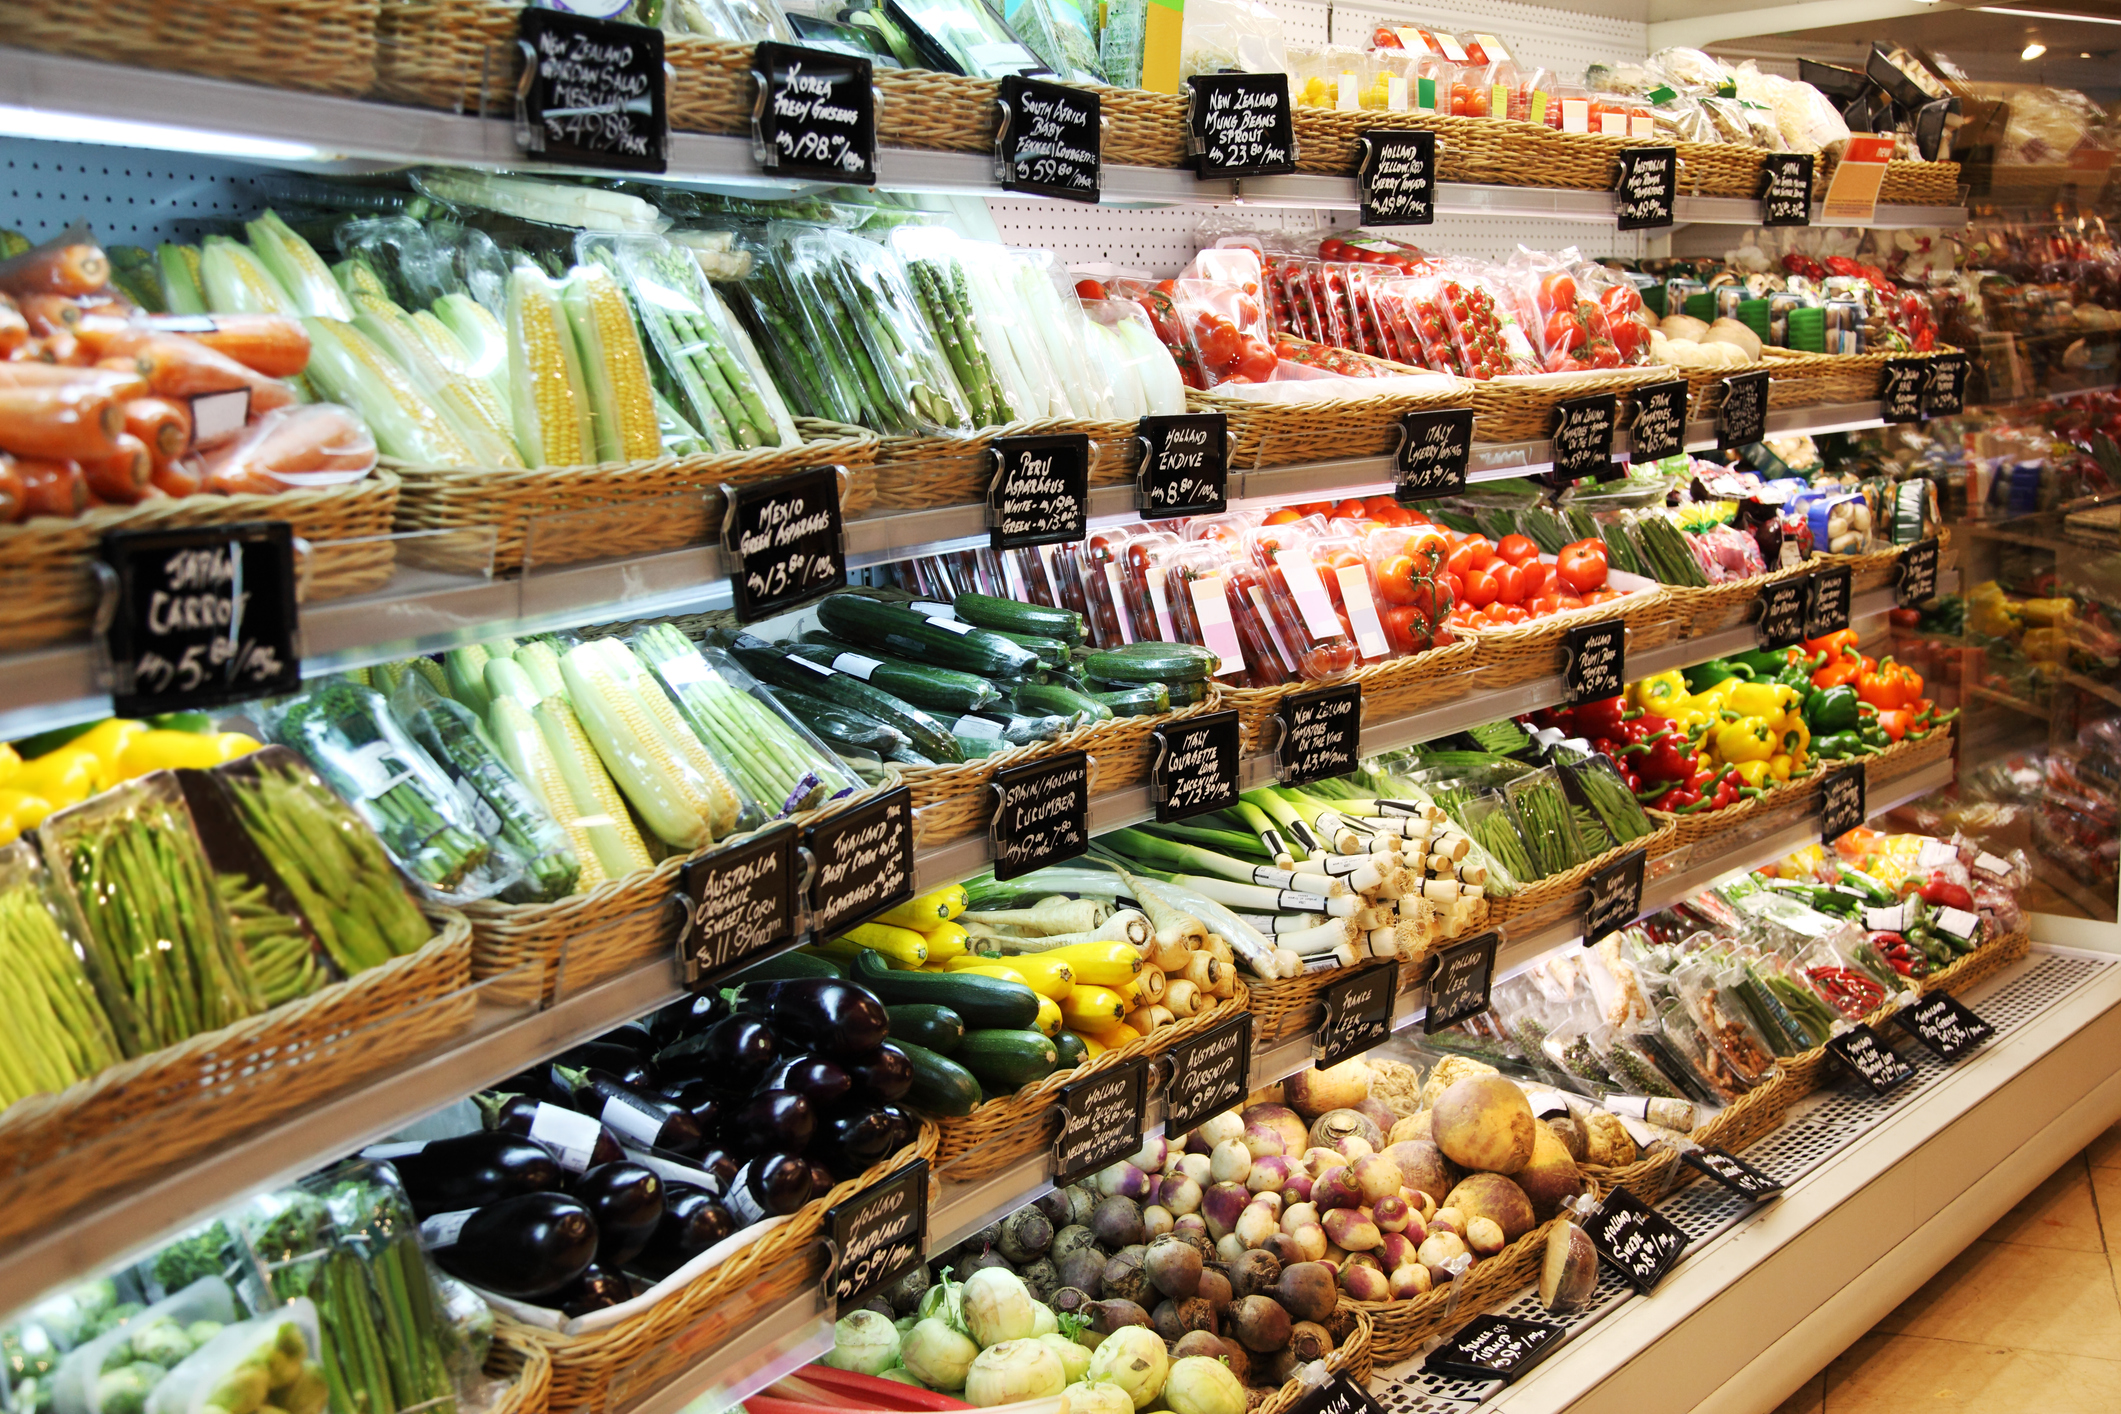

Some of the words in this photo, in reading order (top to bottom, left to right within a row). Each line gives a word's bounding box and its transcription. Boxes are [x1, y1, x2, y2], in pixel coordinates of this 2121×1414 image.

[1022, 92, 1054, 122] SOUTH
[1210, 89, 1231, 110] NEW
[1234, 89, 1277, 110] ZEALAND
[1030, 117, 1064, 141] BABY
[1205, 112, 1236, 134] MUNG
[1239, 110, 1276, 131] BEANS
[1219, 128, 1264, 144] SPROUT
[1380, 144, 1417, 161] HOLLAND
[1371, 174, 1401, 196] CHERRY
[1164, 428, 1207, 450] HOLLAND
[1425, 423, 1455, 443] ITALY
[1020, 451, 1052, 477] PERU
[1159, 451, 1204, 471] ENDIVE
[1408, 441, 1440, 467] CHERRY
[1005, 470, 1065, 497] ASPARAGUS
[1004, 498, 1033, 514] WHITE
[741, 529, 773, 558] GREEN
[774, 510, 830, 546] ASPARAGUS
[1003, 518, 1031, 534] GREEN
[1585, 634, 1612, 653] HOLLAND
[1293, 706, 1314, 725] NEW
[1182, 729, 1210, 750] ITALY
[1291, 722, 1327, 743] TOMATOES
[1168, 746, 1217, 773] COURGETTE
[1015, 791, 1075, 832] CUCUMBER
[833, 821, 887, 862] THAILAND
[704, 852, 777, 900] AUSTRALIA
[821, 858, 852, 887] BABY
[851, 847, 878, 873] CORN
[696, 886, 751, 925] ORGANIC
[823, 880, 876, 921] ASPARAGUS
[704, 906, 743, 940] SWEET
[747, 897, 776, 922] CORN
[1449, 952, 1481, 980] HOLLAND
[1445, 974, 1471, 995] LEEK
[1342, 989, 1372, 1011] FRANCE
[1333, 1012, 1362, 1034] LEEK
[1186, 1031, 1239, 1071] AUSTRALIA
[1181, 1056, 1234, 1095] PARSNIP
[1084, 1080, 1126, 1112] HOLLAND
[1068, 1112, 1092, 1134] GREEN
[1067, 1138, 1093, 1161] YELLOW
[850, 1191, 905, 1238] HOLLAND
[1604, 1210, 1632, 1246] HOLLAND
[839, 1213, 911, 1270] EGGPLANT
[1613, 1231, 1645, 1263] SWEDE
[1459, 1331, 1493, 1353] FRANCE
[1472, 1334, 1512, 1362] TURNIP
